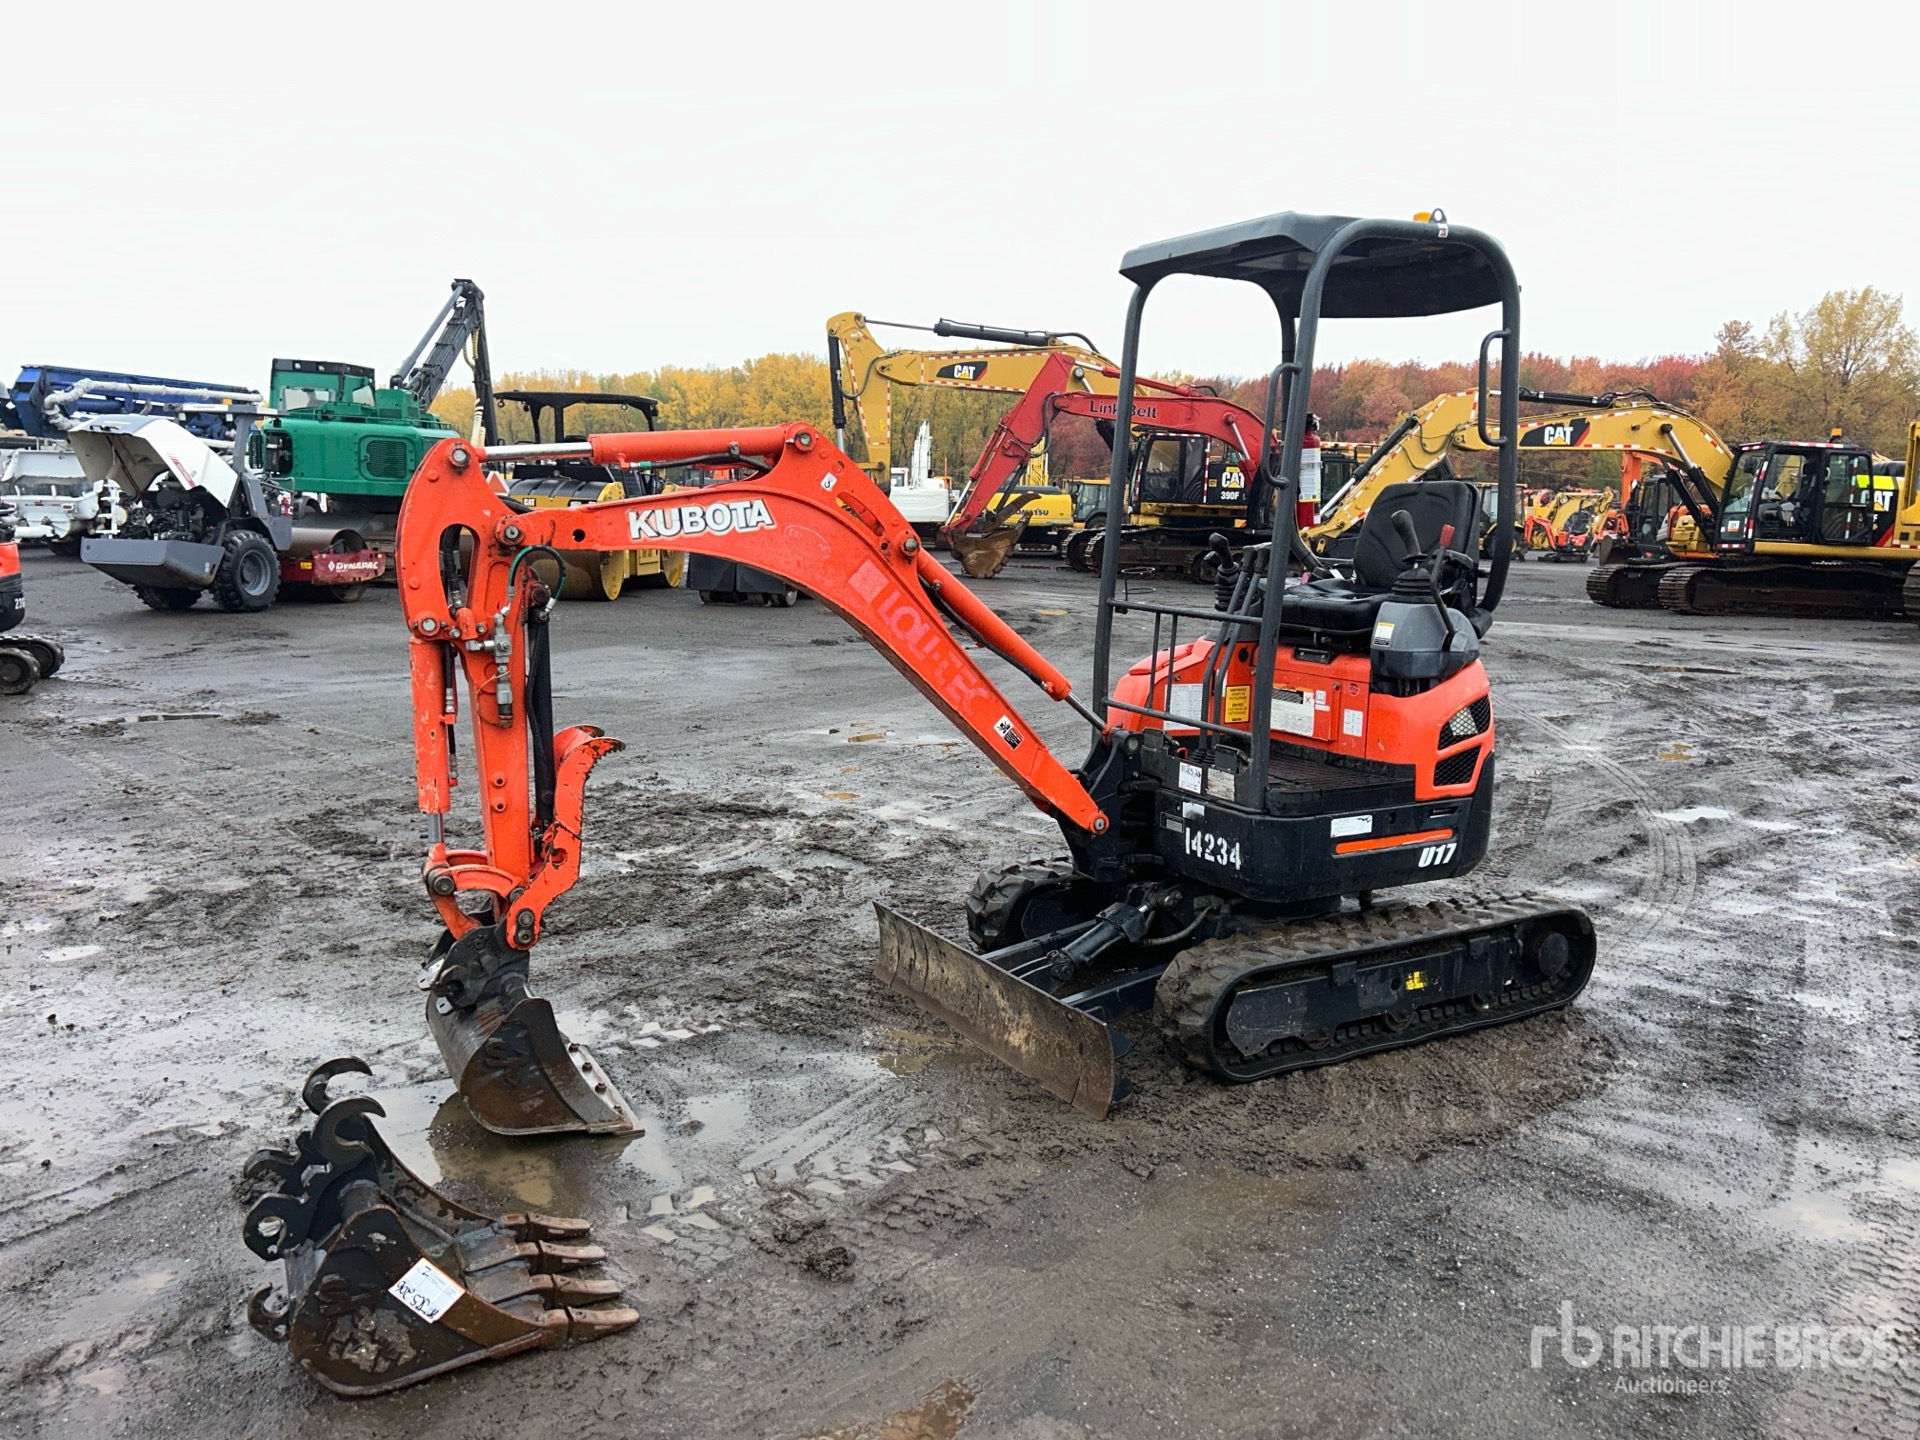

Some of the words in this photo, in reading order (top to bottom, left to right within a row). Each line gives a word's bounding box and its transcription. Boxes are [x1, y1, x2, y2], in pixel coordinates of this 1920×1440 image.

[954, 364, 976, 380] CAT
[1544, 426, 1573, 446] CAT
[1221, 471, 1245, 489] CAT
[523, 498, 535, 507] CAT
[1220, 491, 1240, 500] 390F
[628, 499, 775, 540] KUBOTA
[335, 561, 379, 571] DYNAPAC
[1185, 827, 1242, 871] 14234
[1418, 843, 1457, 868] U17
